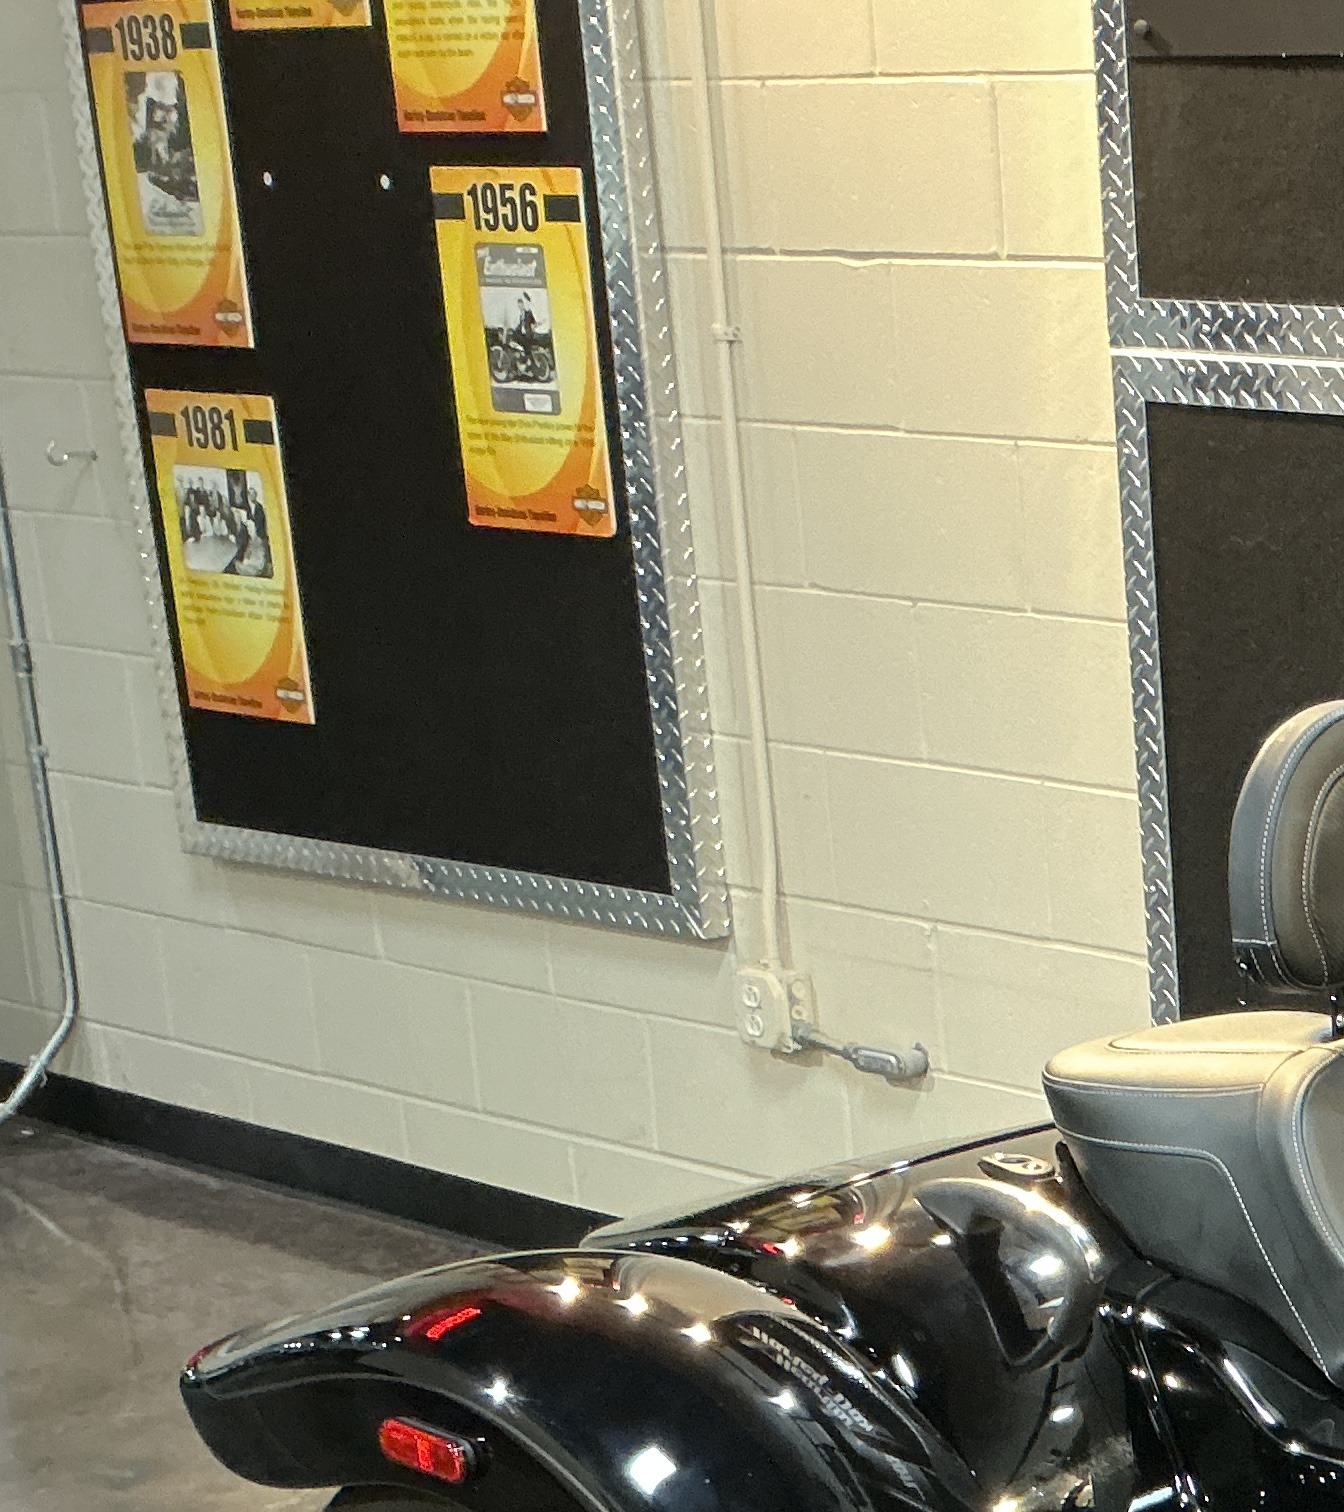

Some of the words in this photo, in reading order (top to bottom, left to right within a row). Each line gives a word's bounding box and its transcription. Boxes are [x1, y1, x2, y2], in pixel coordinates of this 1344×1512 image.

[115, 13, 178, 61] 1938
[467, 182, 539, 231] 1956
[180, 405, 239, 451] 1981
